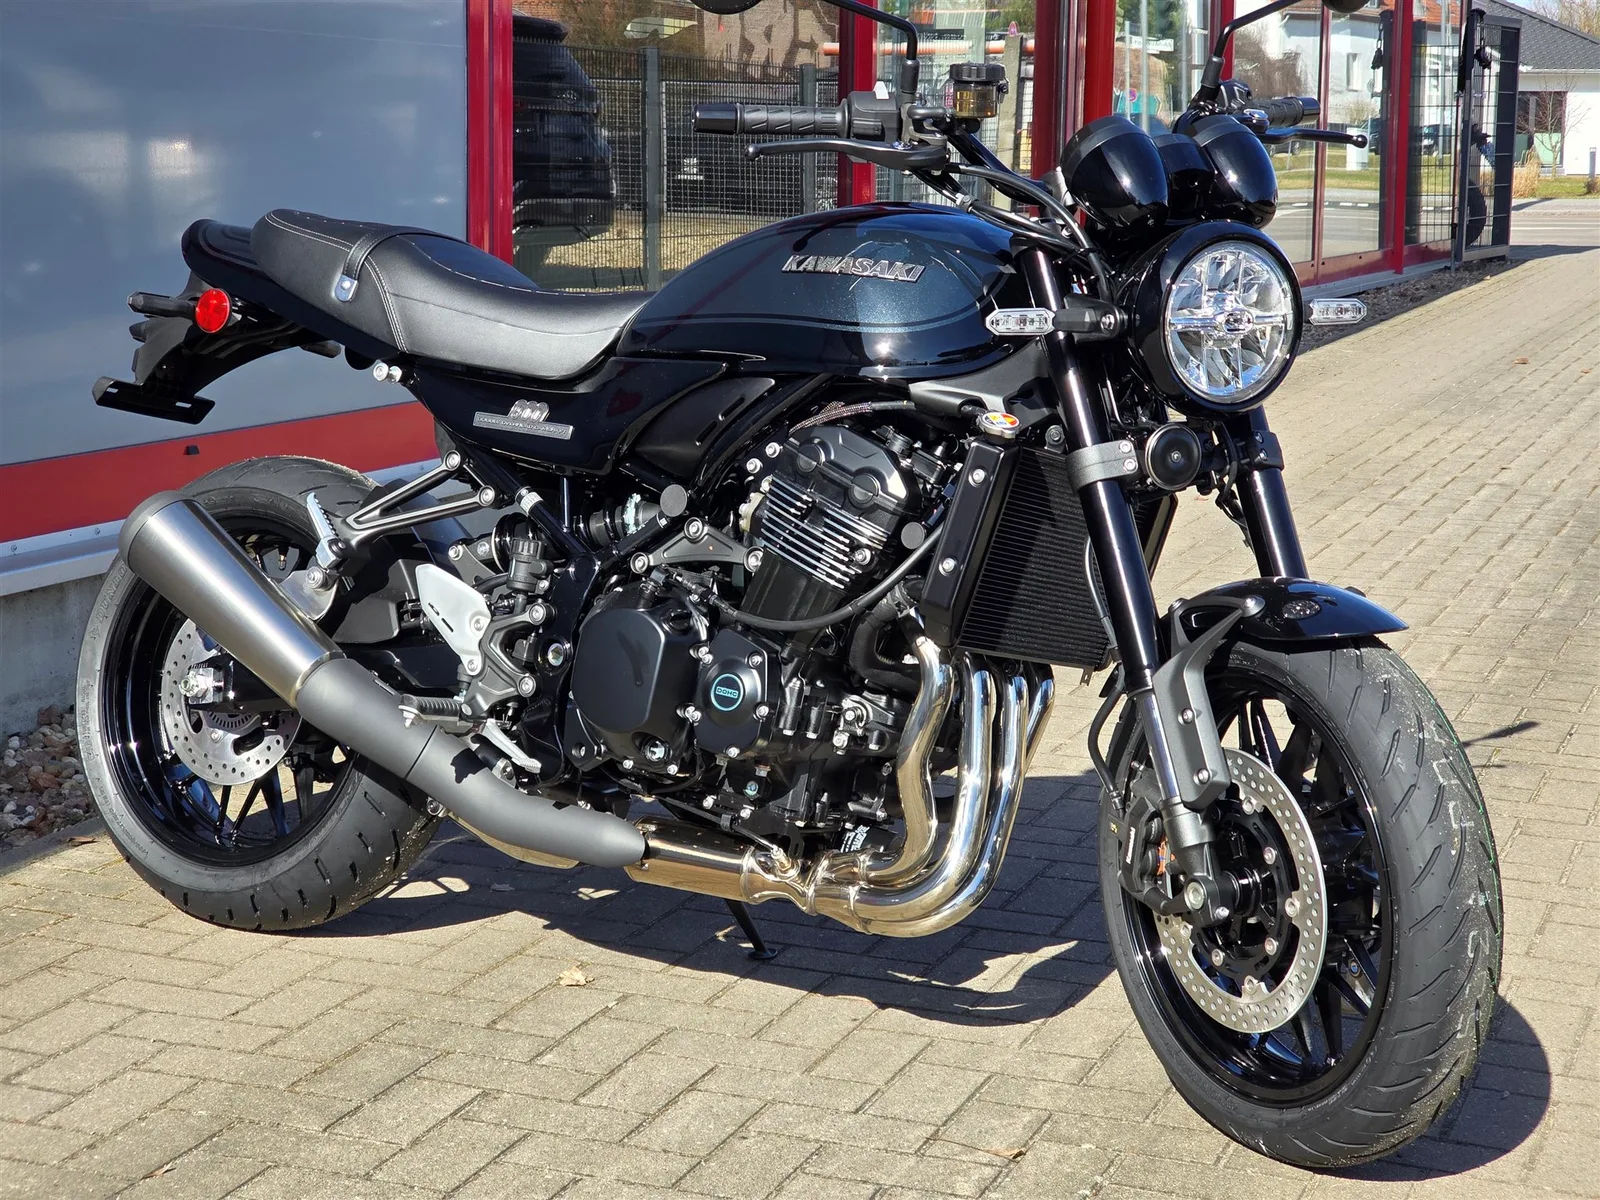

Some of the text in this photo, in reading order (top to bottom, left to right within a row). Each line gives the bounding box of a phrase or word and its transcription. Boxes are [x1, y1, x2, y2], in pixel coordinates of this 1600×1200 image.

[782, 255, 926, 283] KAWASAKI
[95, 563, 127, 624] DUNLO
[717, 687, 738, 697] DOHC
